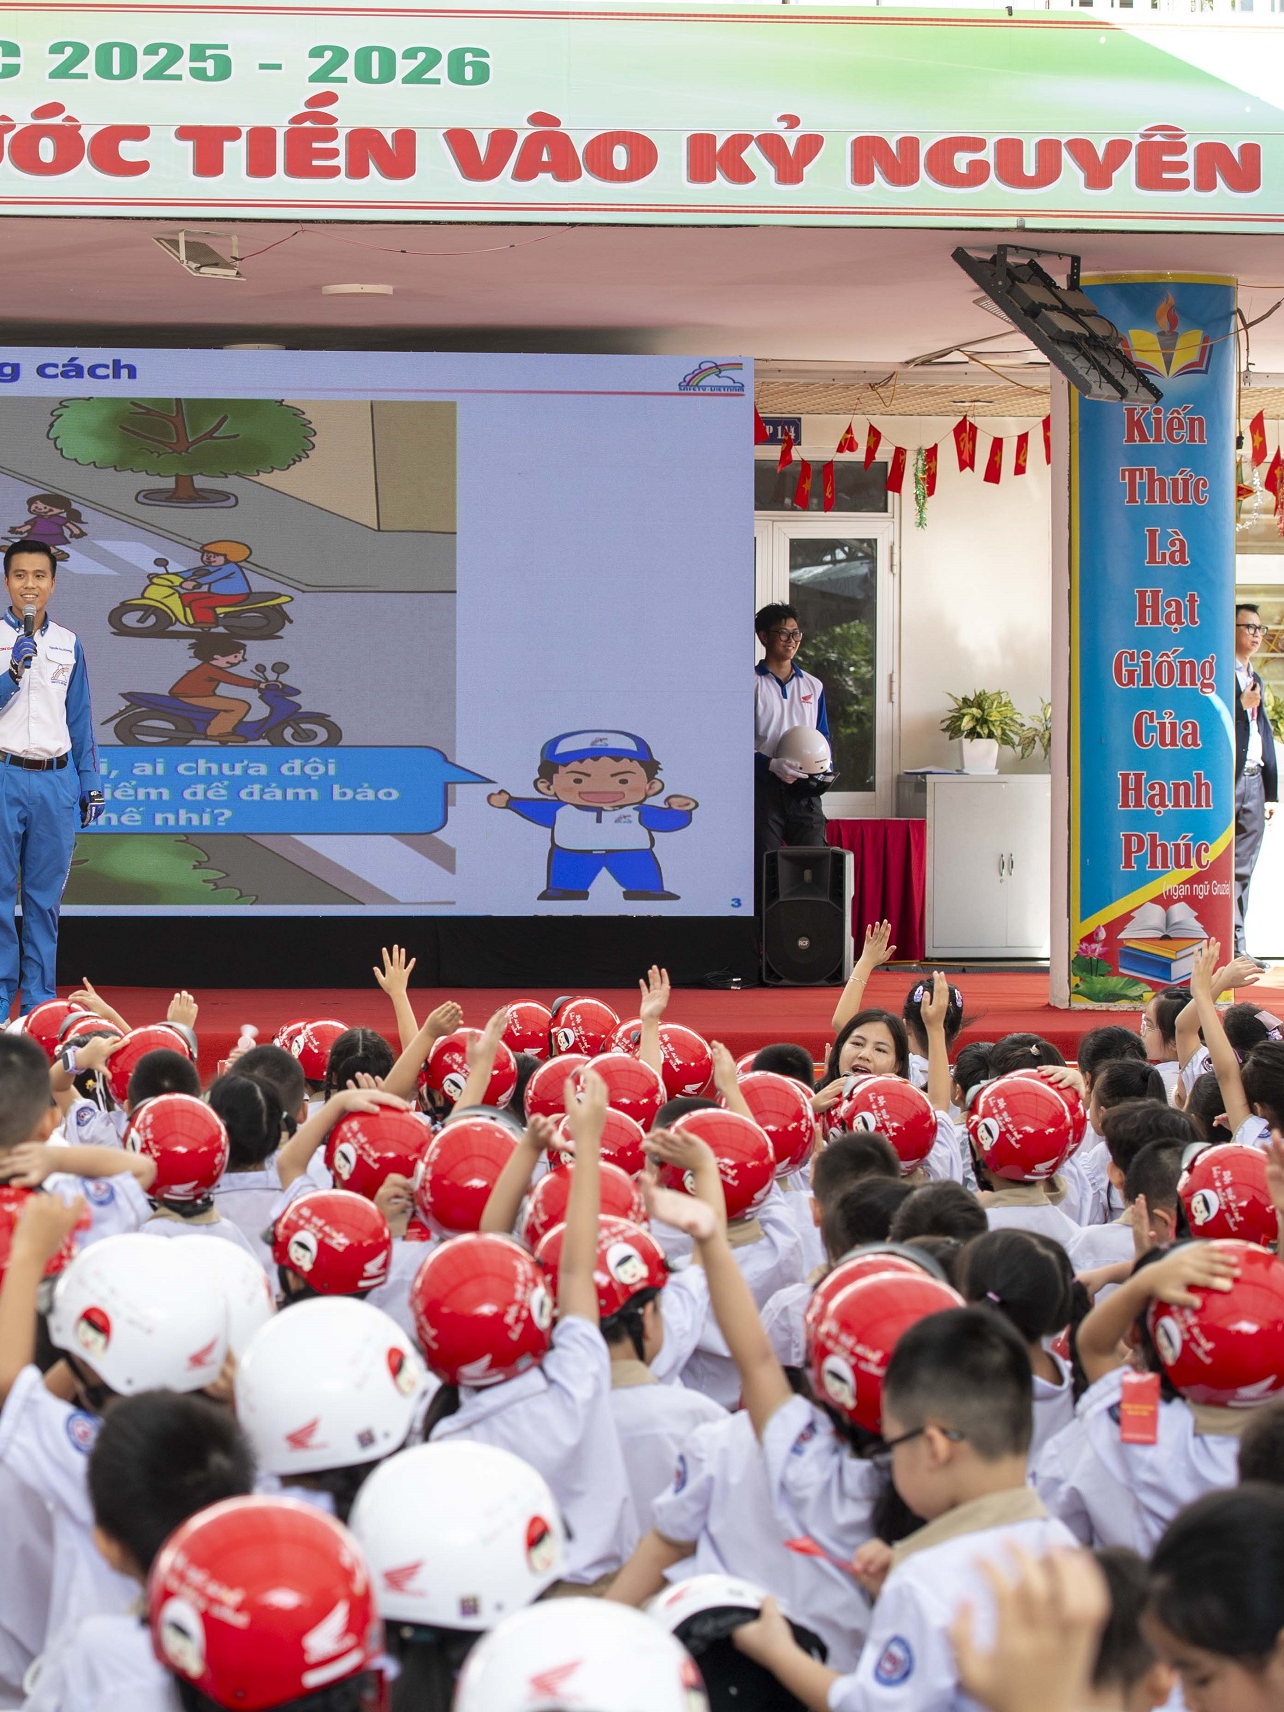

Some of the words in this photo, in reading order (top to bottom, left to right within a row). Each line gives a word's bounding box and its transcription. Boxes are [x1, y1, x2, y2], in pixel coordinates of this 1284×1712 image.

[48, 40, 233, 81] 2025
[258, 62, 283, 71] -
[308, 44, 491, 86] 2026
[176, 90, 417, 180] TIẾN
[442, 111, 659, 184] VÀO
[686, 114, 825, 185] KỶ
[850, 124, 1262, 193] NGUYÊN
[36, 357, 138, 381] cách
[1123, 404, 1207, 445] Kiến
[1120, 467, 1209, 505] Thức
[1145, 527, 1189, 566] Là
[1135, 588, 1200, 633] Hạt
[1113, 648, 1216, 695] Giống
[1133, 710, 1201, 749] Của
[133, 758, 165, 775] ai
[177, 758, 268, 776] chưa
[280, 757, 337, 779] đội
[103, 780, 170, 800] iểm
[182, 780, 230, 801] để
[238, 783, 320, 801] đảm
[331, 783, 401, 801] bảo
[1118, 771, 1213, 816] Hạnh
[89, 807, 145, 826] hế
[154, 807, 233, 826] nhỉ?
[1121, 832, 1210, 871] Phúc
[730, 897, 742, 908] 3
[1193, 880, 1210, 900] ngữ
